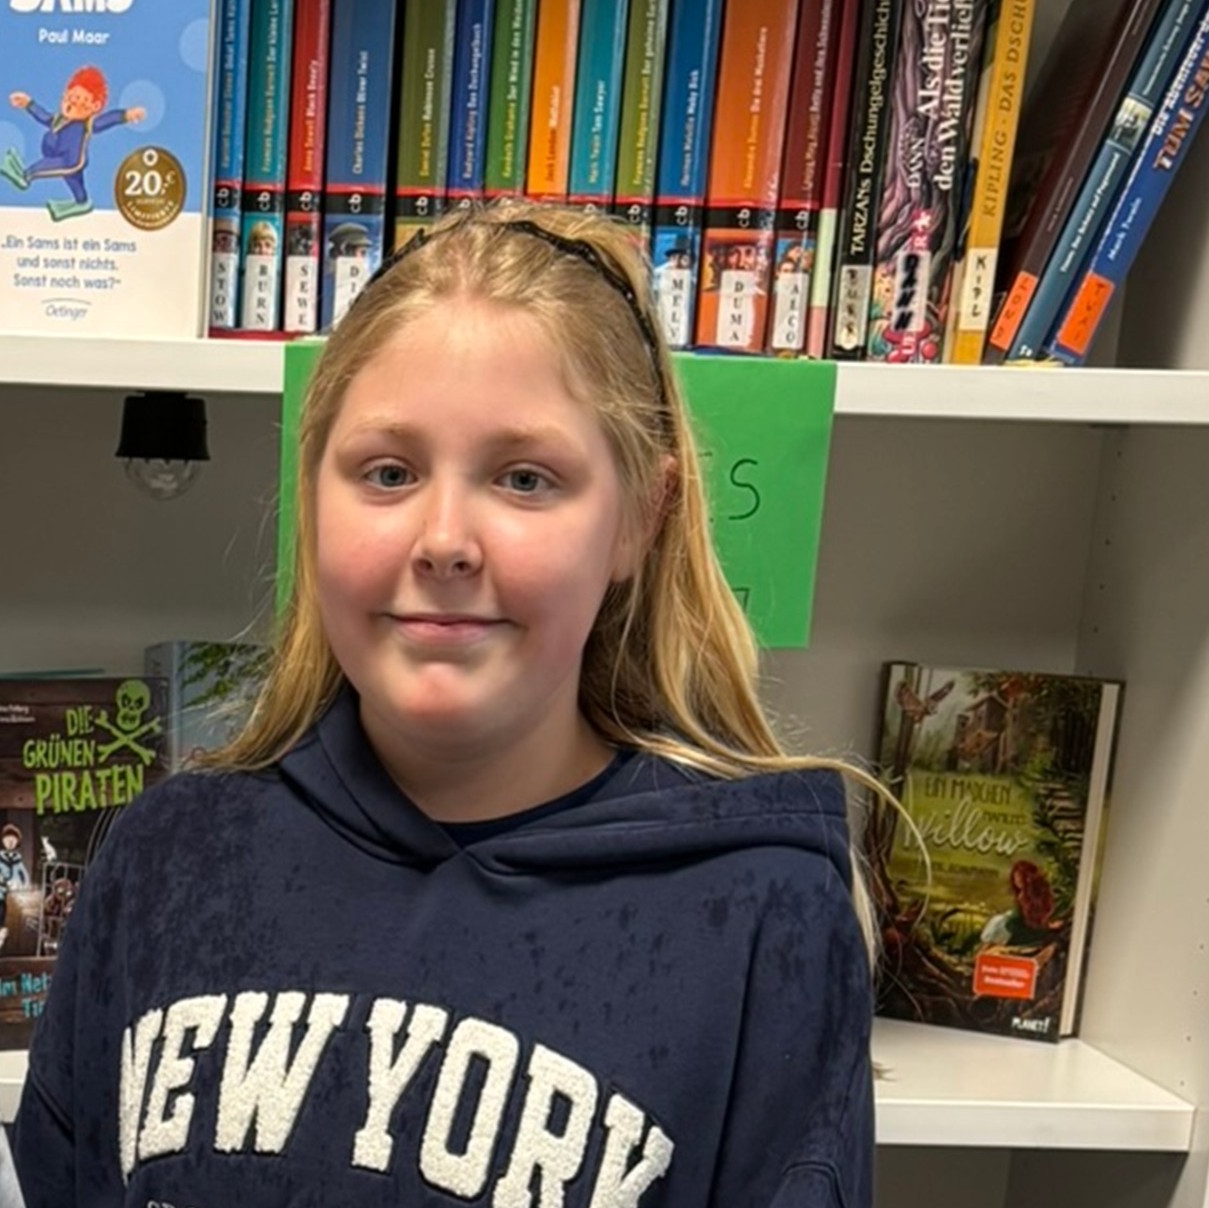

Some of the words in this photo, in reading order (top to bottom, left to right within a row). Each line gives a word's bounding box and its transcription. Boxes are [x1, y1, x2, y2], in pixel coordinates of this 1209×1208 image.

[38, 28, 69, 44] Paul
[72, 29, 110, 45] Maar
[510, 31, 522, 48] den
[754, 27, 767, 76] Musketiere
[922, 31, 947, 71] die
[357, 51, 369, 75] Twist
[425, 48, 436, 79] Crusoe
[468, 23, 482, 91] Dschungelbuch
[508, 60, 519, 82] Wind
[307, 59, 319, 91] Beauty
[356, 77, 367, 103] Oliver
[751, 78, 763, 95] drei
[306, 92, 317, 118] Black
[424, 81, 435, 121] Robinson
[468, 92, 479, 108] Das
[507, 84, 518, 100] Der
[592, 80, 606, 113] Sawyer
[686, 91, 699, 115] Moby
[750, 98, 761, 112] Die
[916, 77, 942, 118] Als
[354, 105, 366, 139] Dickens
[591, 115, 603, 134] Tom
[938, 79, 965, 143] Wald
[983, 131, 1008, 219] KIPLING
[997, 68, 1019, 113] DAS
[1153, 107, 1194, 170] TOM
[353, 141, 365, 174] Charles
[933, 145, 957, 191] den
[257, 191, 271, 212] cb
[300, 190, 313, 211] cb
[348, 193, 363, 214] cb
[415, 195, 429, 216] cb
[675, 205, 689, 226] cb
[736, 208, 751, 228] cb
[850, 178, 872, 255] TARZANs
[27, 235, 61, 251] Sams
[63, 237, 79, 251] ist
[82, 238, 102, 252] ein
[104, 237, 137, 252] Sams
[1107, 231, 1127, 261] Mark
[17, 255, 40, 269] und
[43, 256, 76, 270] sonst
[78, 257, 120, 272] nichts.
[13, 273, 48, 288] Sonst
[50, 274, 81, 289] noch
[212, 262, 227, 322] STOW
[256, 264, 268, 323] BURN
[296, 265, 310, 325] SEWE
[971, 255, 987, 318] KIPL
[45, 303, 89, 321] Oetinger
[729, 281, 745, 342] DUMA
[785, 284, 800, 343] ALCO
[65, 706, 94, 737] DIE
[23, 731, 97, 769] GRÜNEN
[35, 764, 145, 816] PIRATEN
[904, 797, 1031, 856] Willow
[118, 991, 350, 1184] NEW
